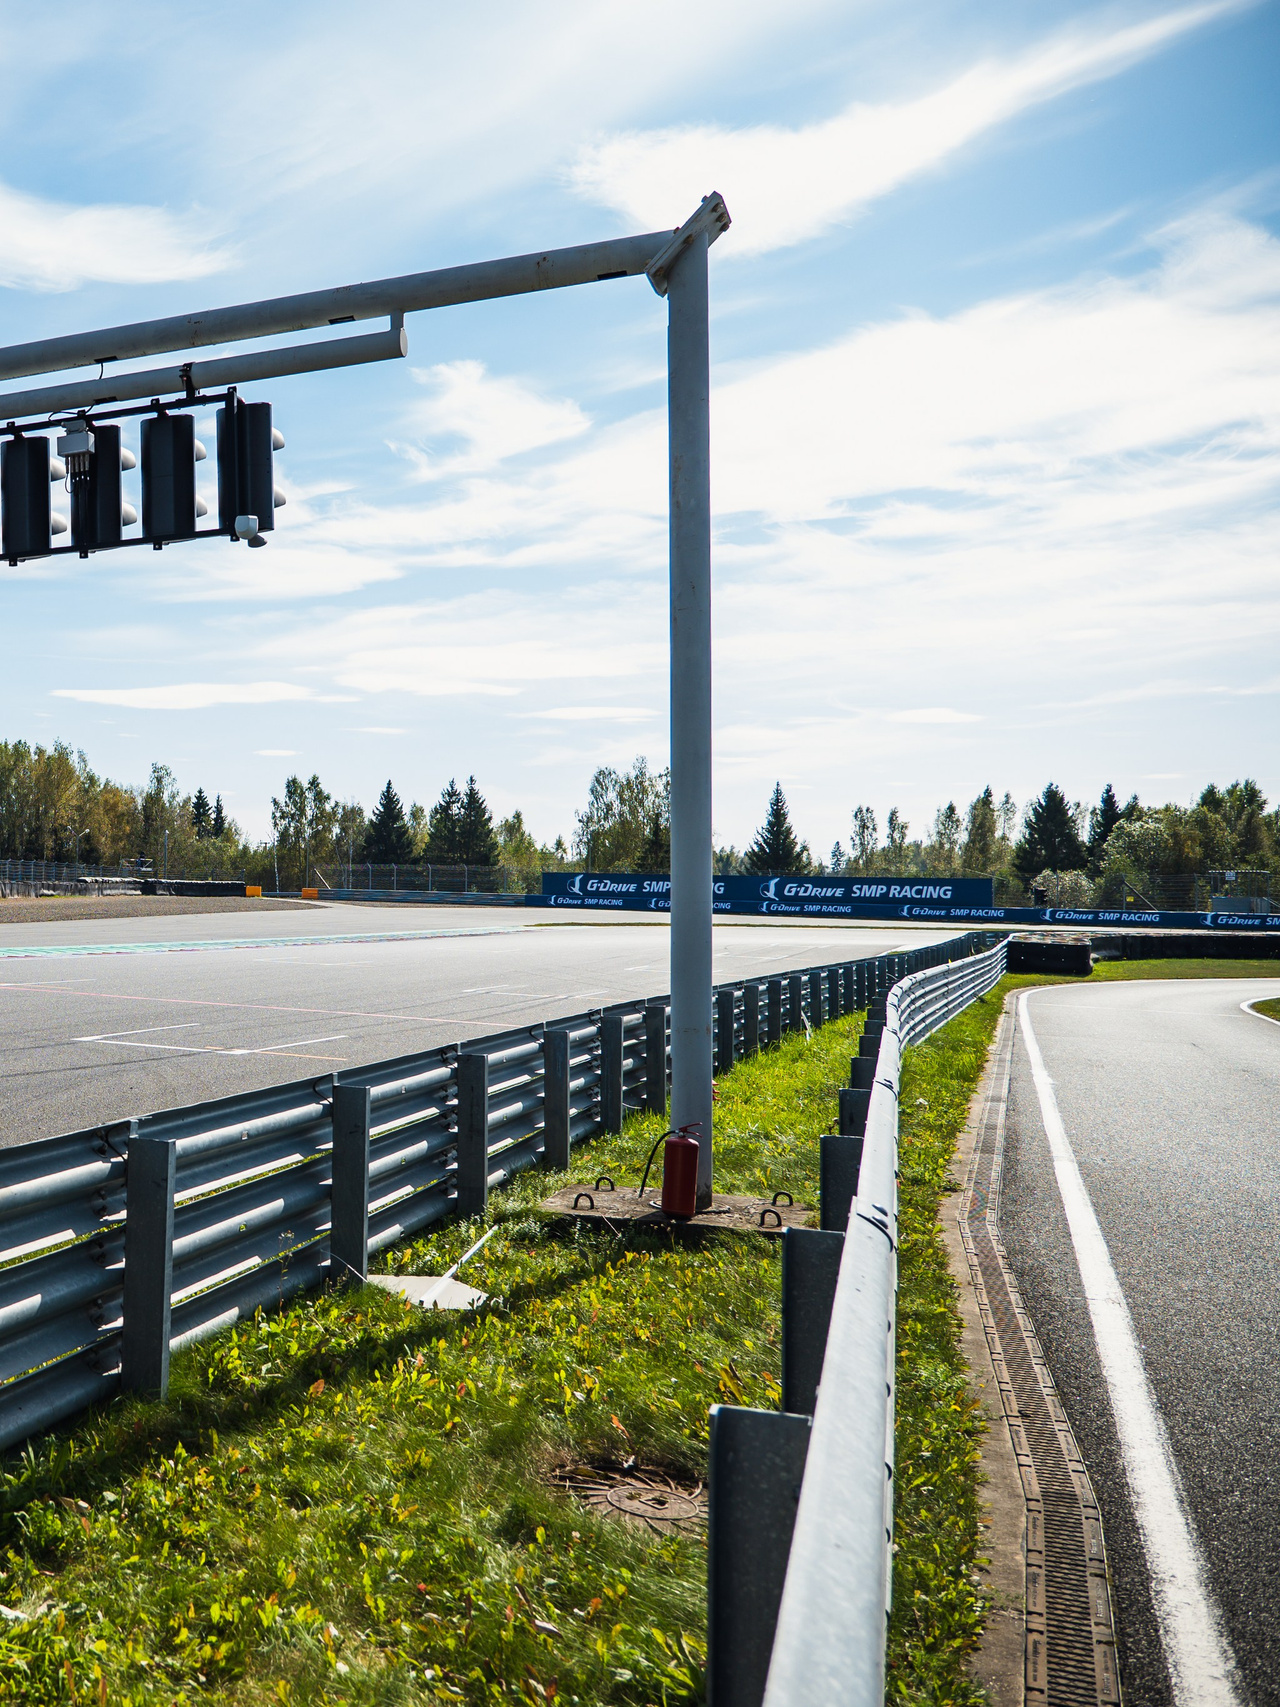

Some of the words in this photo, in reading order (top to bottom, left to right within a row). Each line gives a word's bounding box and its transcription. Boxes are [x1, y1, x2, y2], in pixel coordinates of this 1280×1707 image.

[642, 880, 672, 893] SMP
[851, 884, 887, 898] SMP
[888, 885, 953, 899] RACING
[803, 904, 821, 912] SMP
[821, 905, 852, 913] RACING
[950, 908, 970, 916] SMP
[970, 909, 1005, 917] RACING
[1098, 912, 1120, 921] SMP
[1121, 913, 1160, 922] RACING
[1265, 917, 1280, 926] SM
